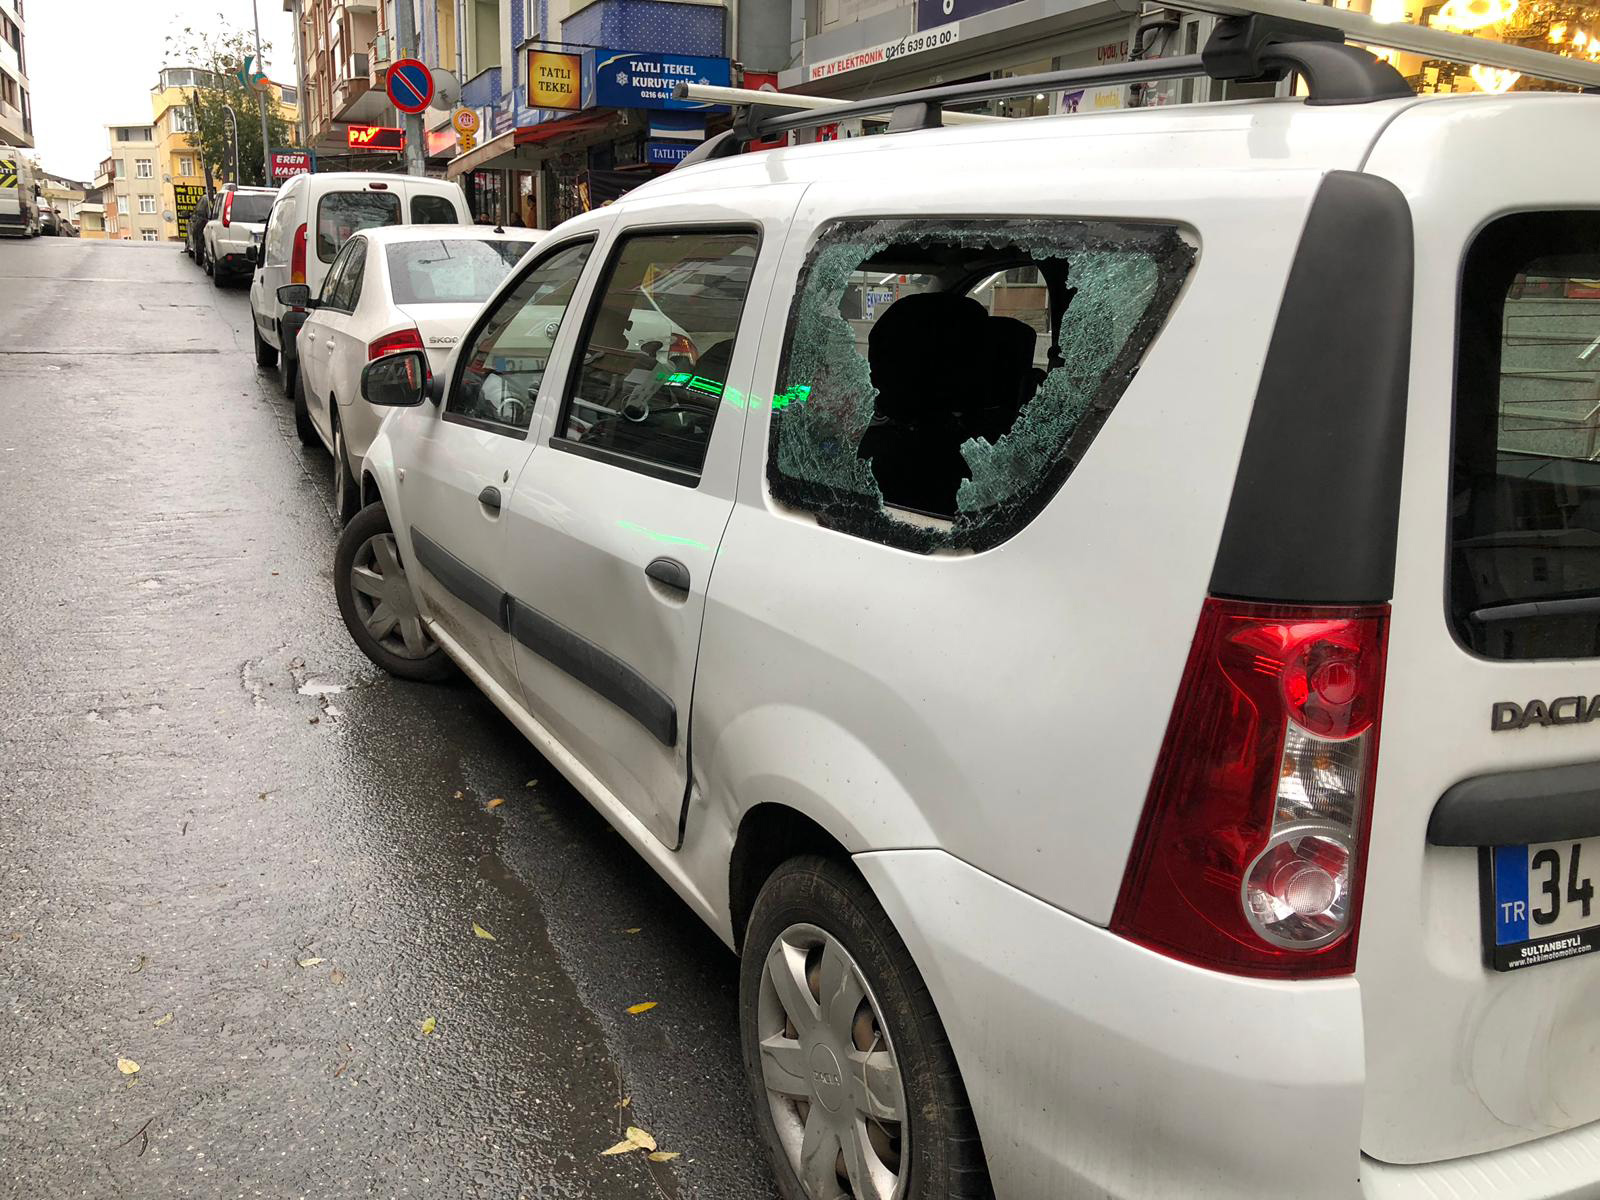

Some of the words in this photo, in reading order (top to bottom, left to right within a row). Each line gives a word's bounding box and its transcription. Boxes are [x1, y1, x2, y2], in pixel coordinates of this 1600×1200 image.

[812, 66, 826, 78] NET
[826, 63, 836, 75] AY
[907, 38, 924, 52] 639
[926, 34, 938, 48] 03
[939, 30, 952, 45] 00
[539, 66, 572, 80] TATLI
[630, 61, 661, 74] TATLI
[662, 63, 697, 76] TEKEL
[538, 80, 573, 94] TEKEL
[641, 90, 657, 99] 0216
[276, 155, 305, 164] EREN
[653, 148, 675, 159] TATLI
[187, 186, 204, 195] OTO
[428, 336, 460, 344] SKOD
[1501, 900, 1526, 924] TR
[1531, 843, 1594, 926] 34
[1520, 935, 1581, 958] SULTANBEYLİ
